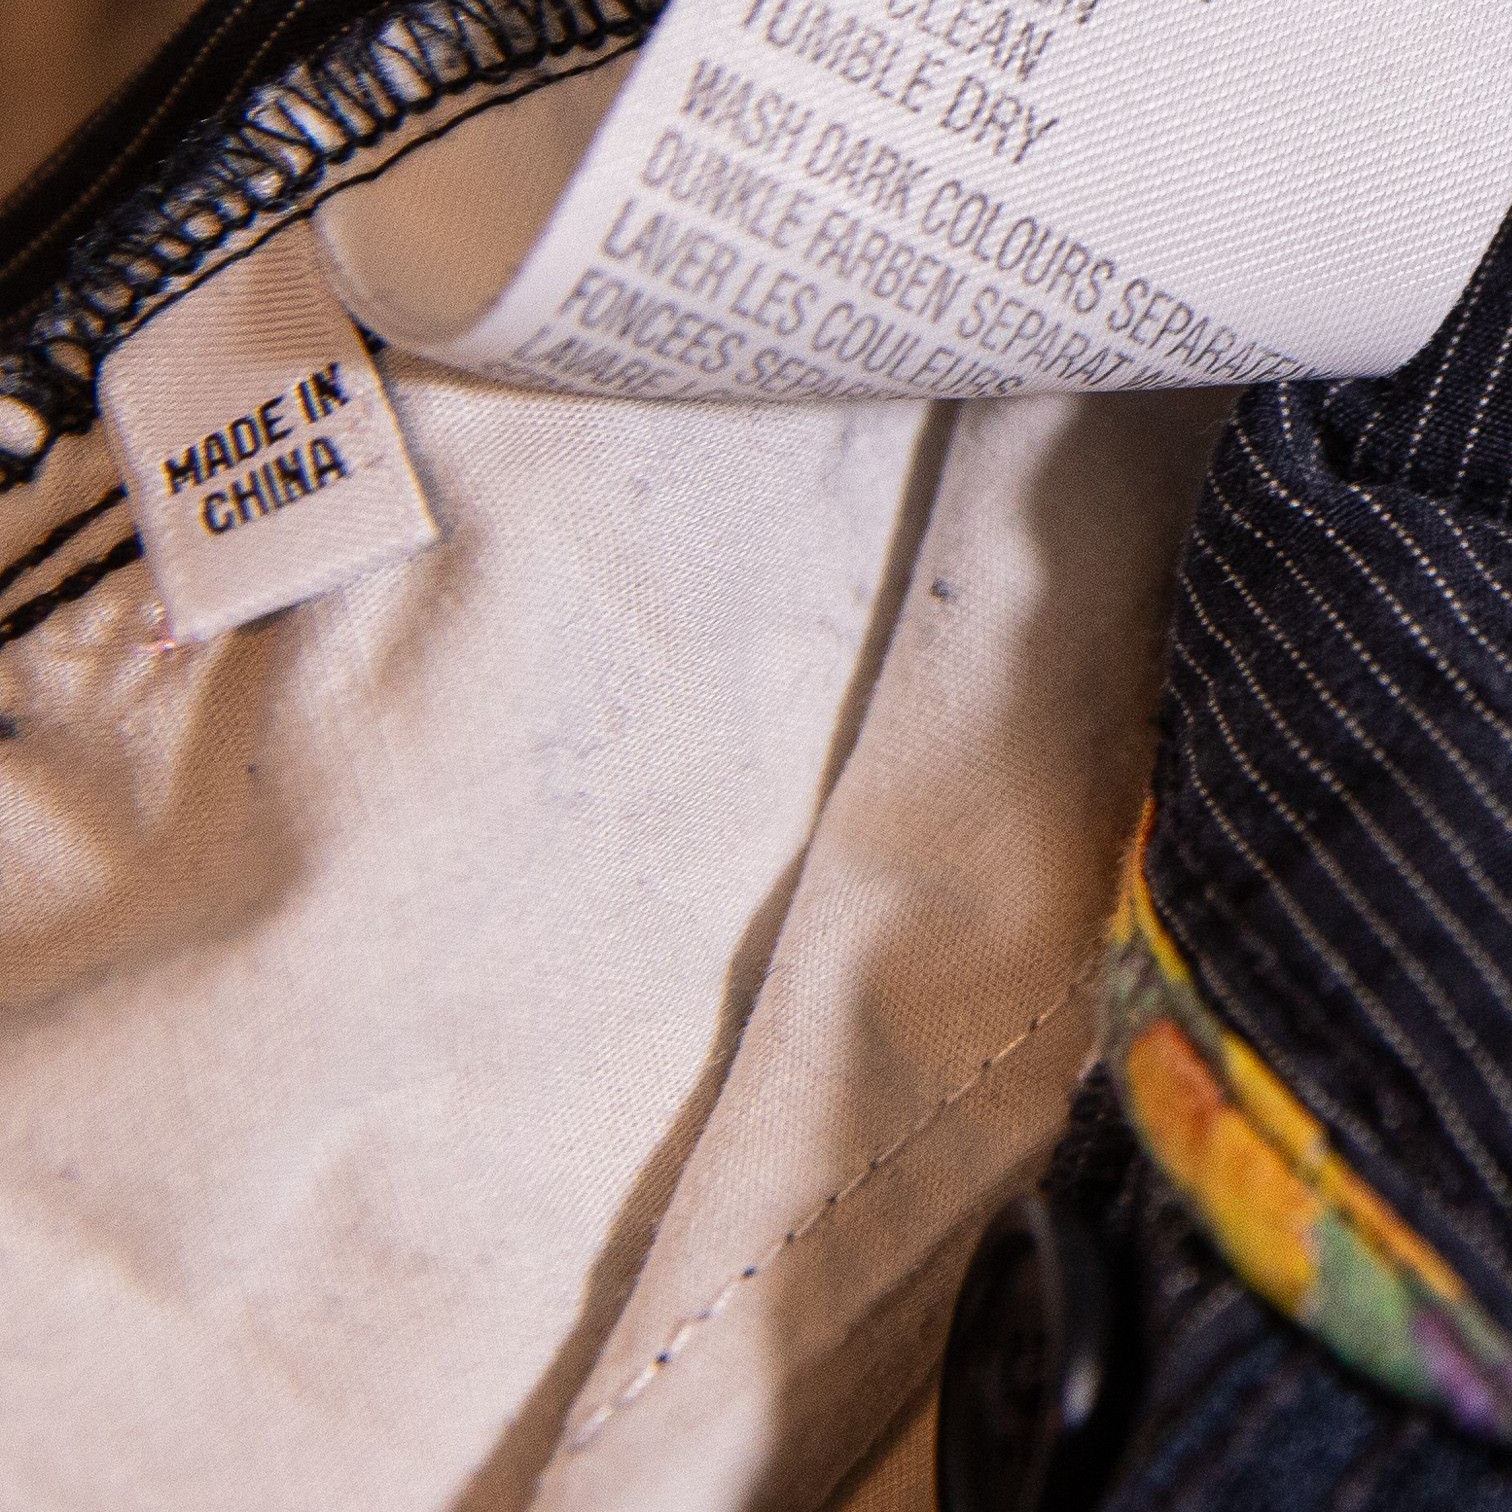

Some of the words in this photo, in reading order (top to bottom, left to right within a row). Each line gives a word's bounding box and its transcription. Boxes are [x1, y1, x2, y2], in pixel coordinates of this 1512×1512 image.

[939, 74, 1059, 164] DRY
[681, 59, 816, 164] WASH
[803, 122, 930, 219] DARK
[921, 178, 1116, 315] COLOURS
[558, 266, 748, 373] FONCEES
[602, 198, 740, 300] LAVER
[731, 262, 820, 336] LES
[641, 126, 816, 249] DUNKLE
[803, 209, 969, 324] FARBEN
[957, 285, 1135, 386] SEPARAT
[161, 394, 294, 496] MADE
[294, 361, 350, 425] IN
[199, 436, 350, 536] CHINA
